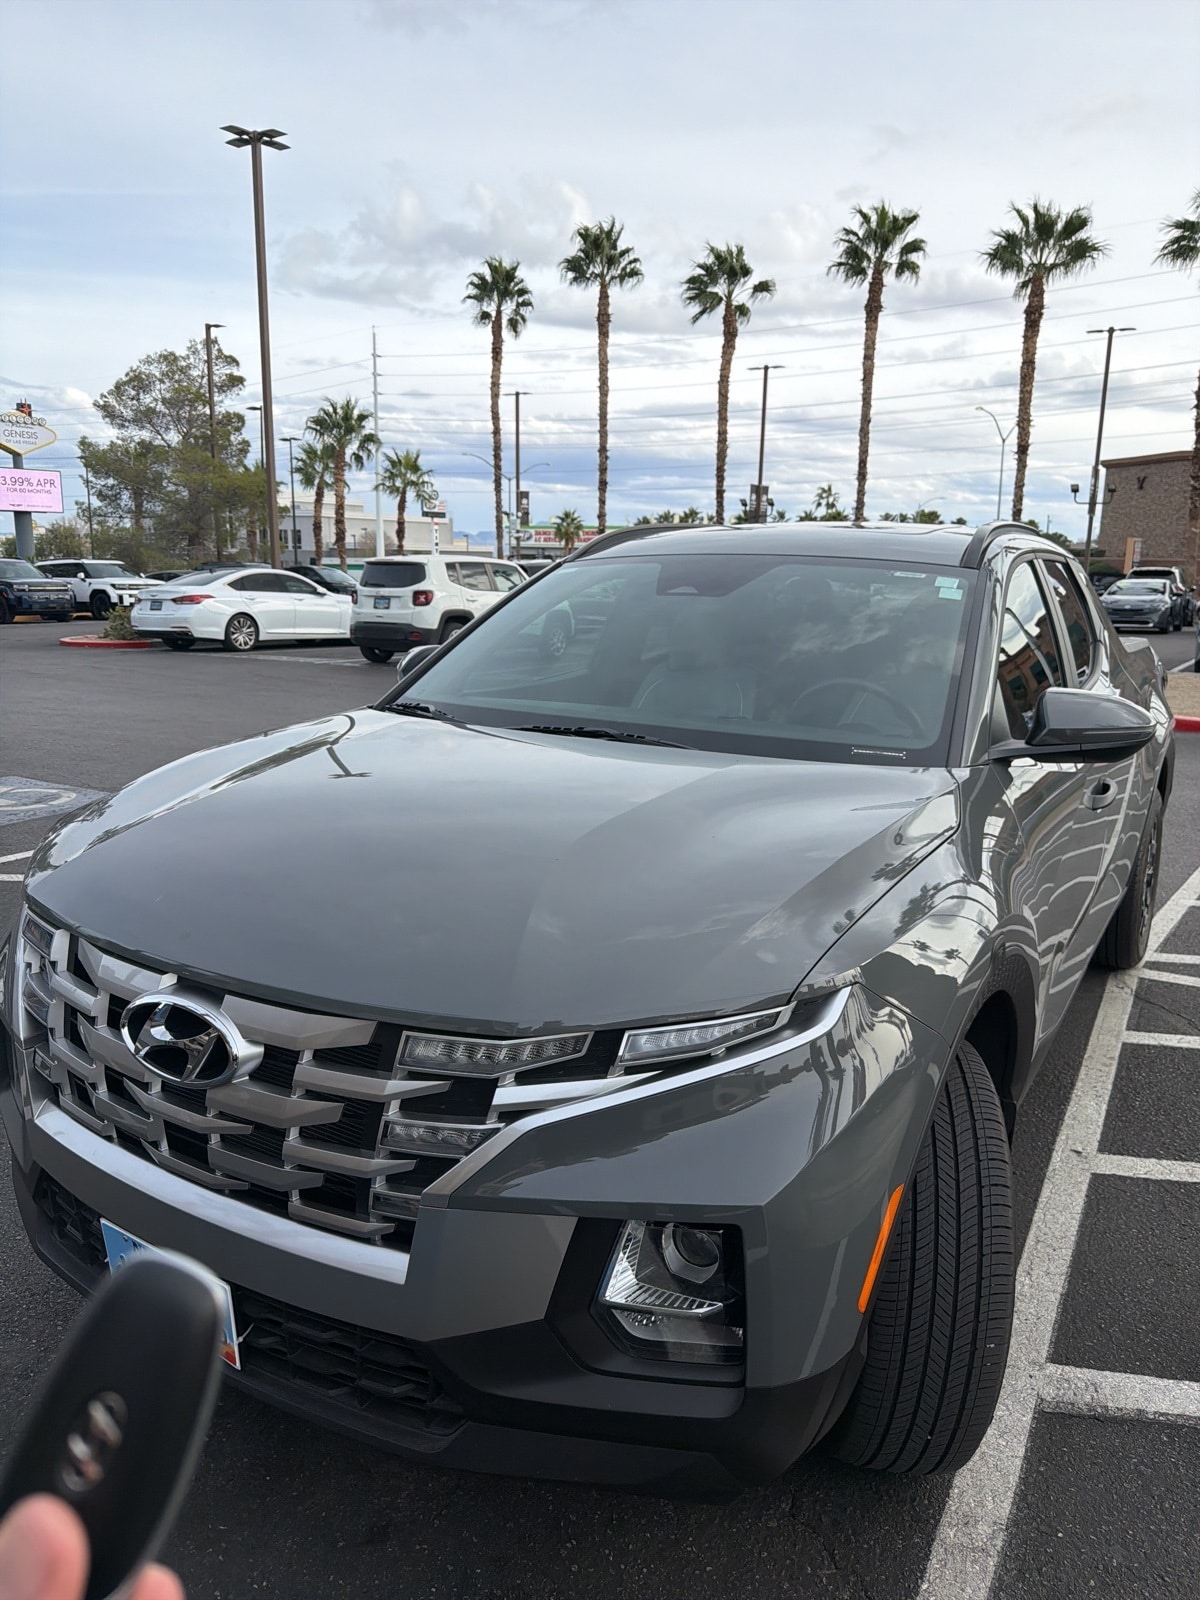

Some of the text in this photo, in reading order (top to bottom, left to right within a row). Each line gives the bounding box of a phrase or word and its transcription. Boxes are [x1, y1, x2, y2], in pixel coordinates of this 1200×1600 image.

[0, 415, 46, 425] ELCOME
[3, 429, 38, 439] GENESIS
[1, 476, 57, 488] 3.99% APR
